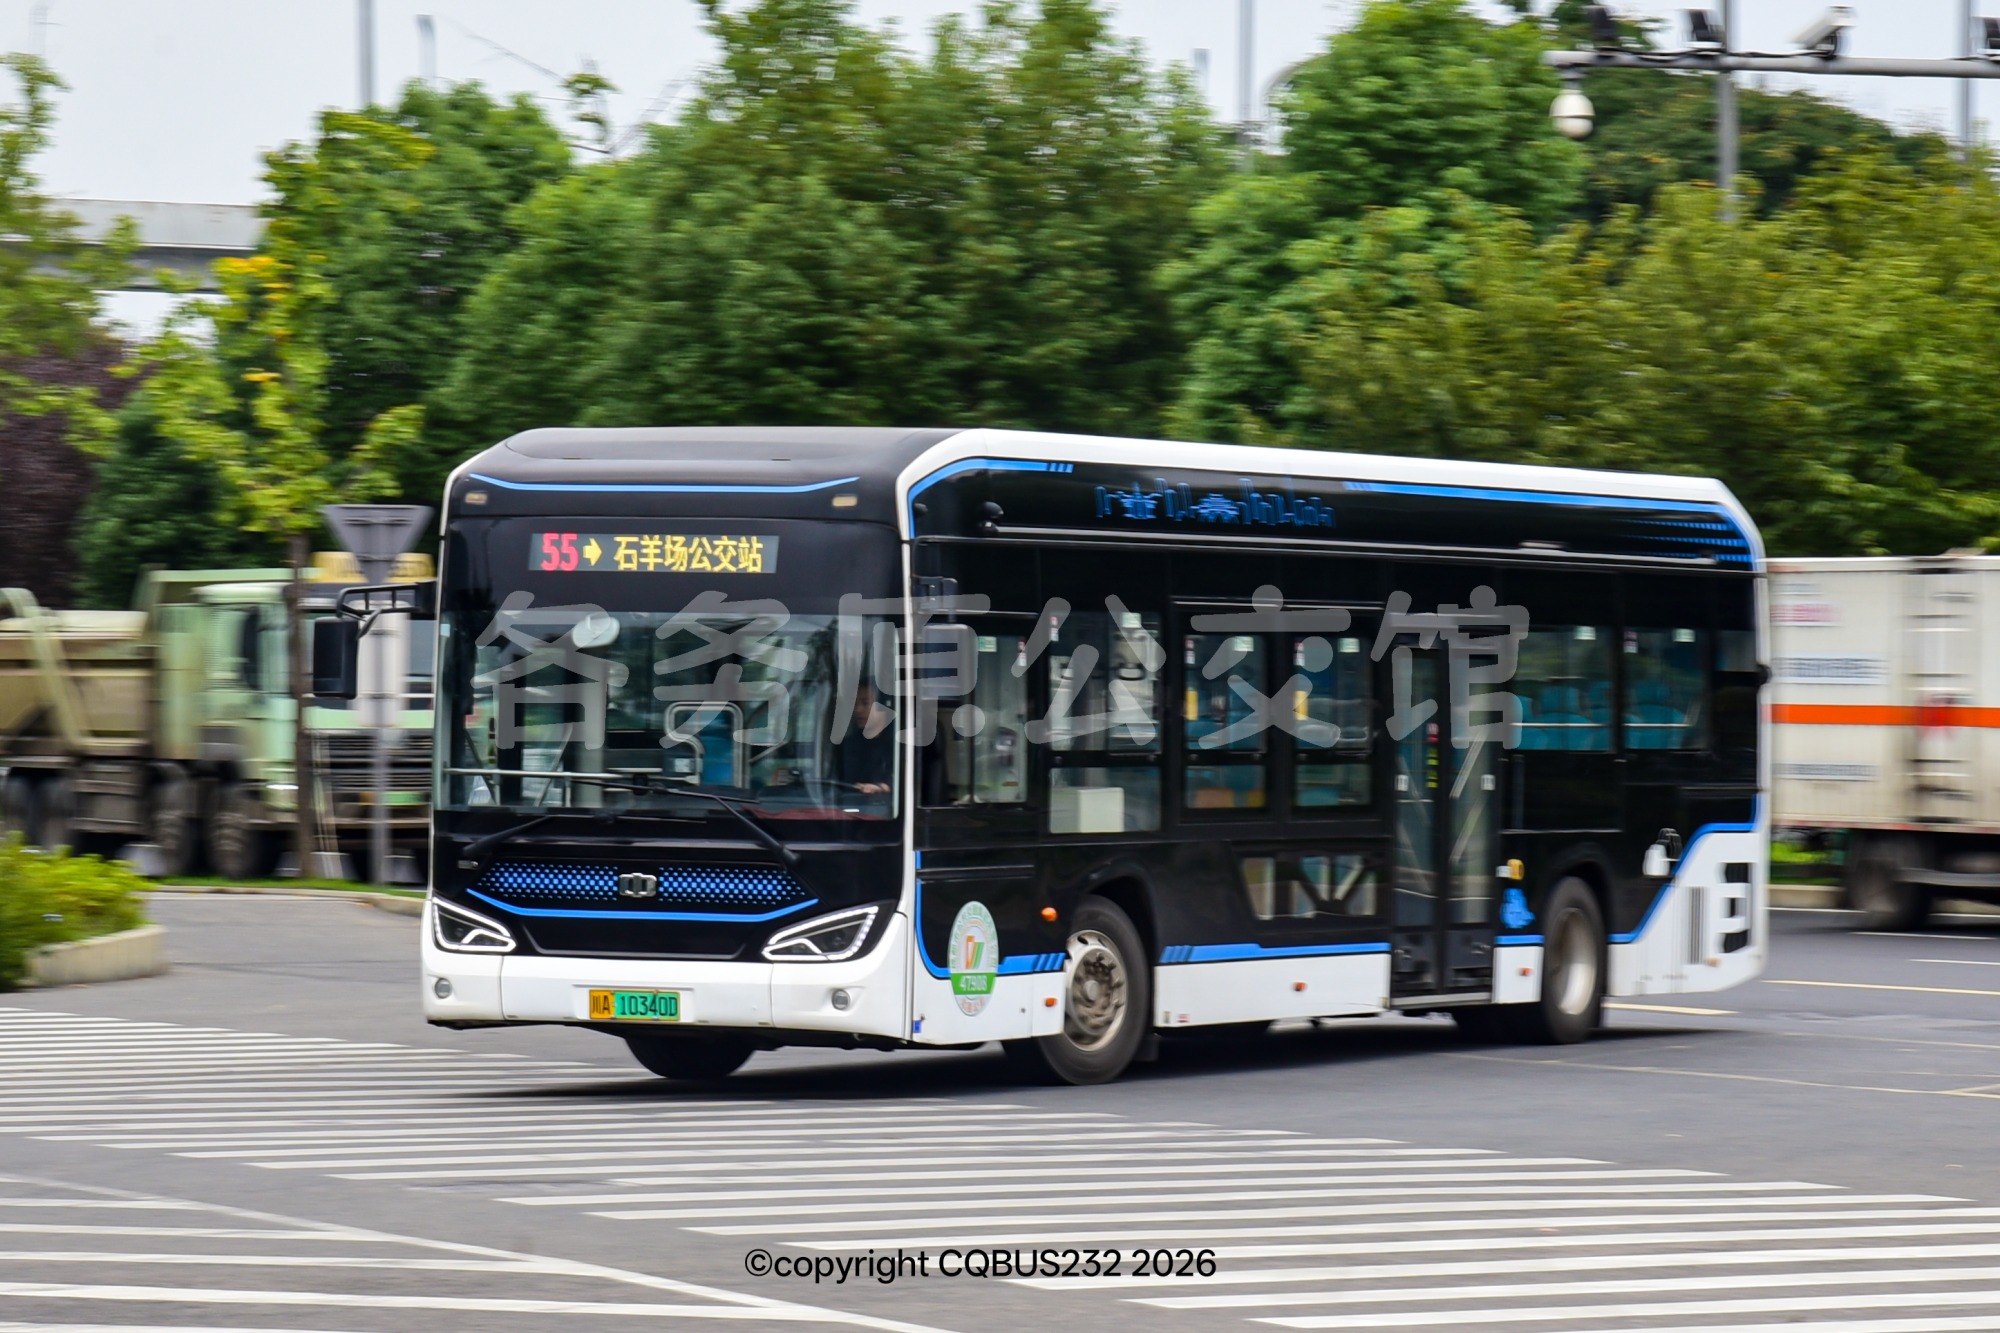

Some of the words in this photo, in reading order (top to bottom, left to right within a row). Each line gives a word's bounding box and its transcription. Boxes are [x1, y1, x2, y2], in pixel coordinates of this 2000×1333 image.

[540, 532, 579, 571] 55
[613, 534, 763, 572] 石羊场公交站
